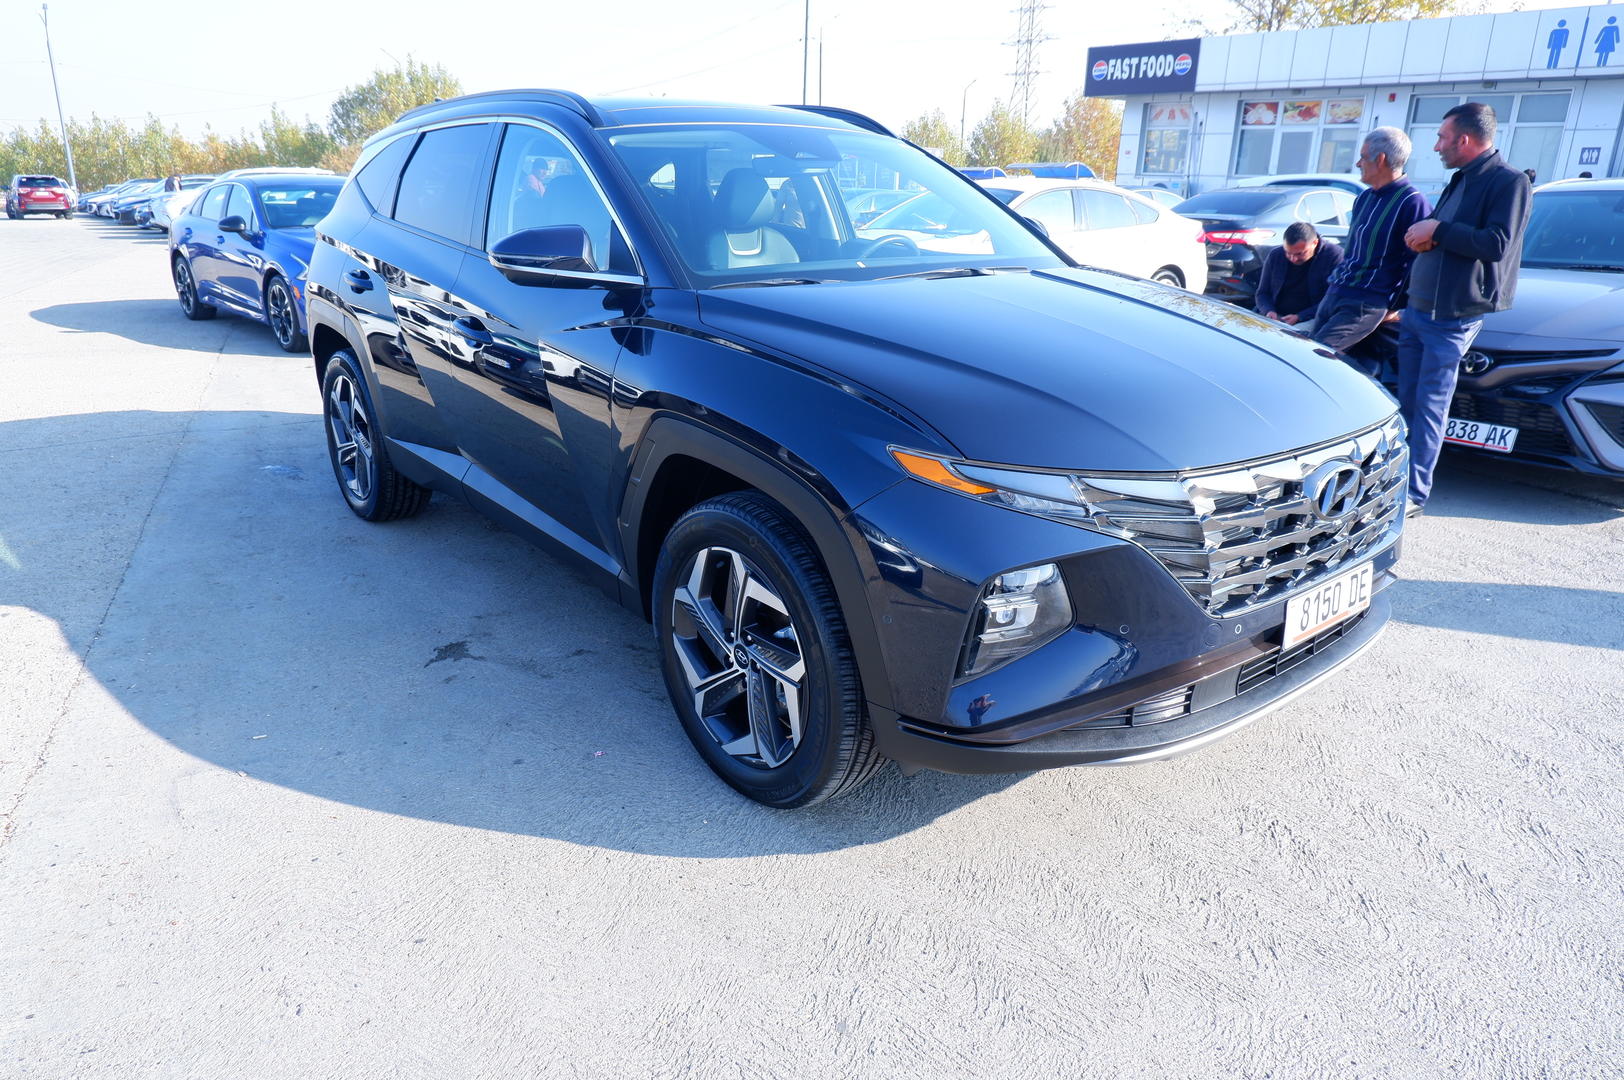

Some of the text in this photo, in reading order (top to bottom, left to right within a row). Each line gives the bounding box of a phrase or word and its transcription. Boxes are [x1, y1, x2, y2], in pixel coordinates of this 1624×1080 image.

[1107, 54, 1174, 80] FAST FOOD
[1445, 420, 1512, 447] 838 AK
[1300, 568, 1369, 632] 8150 DE
